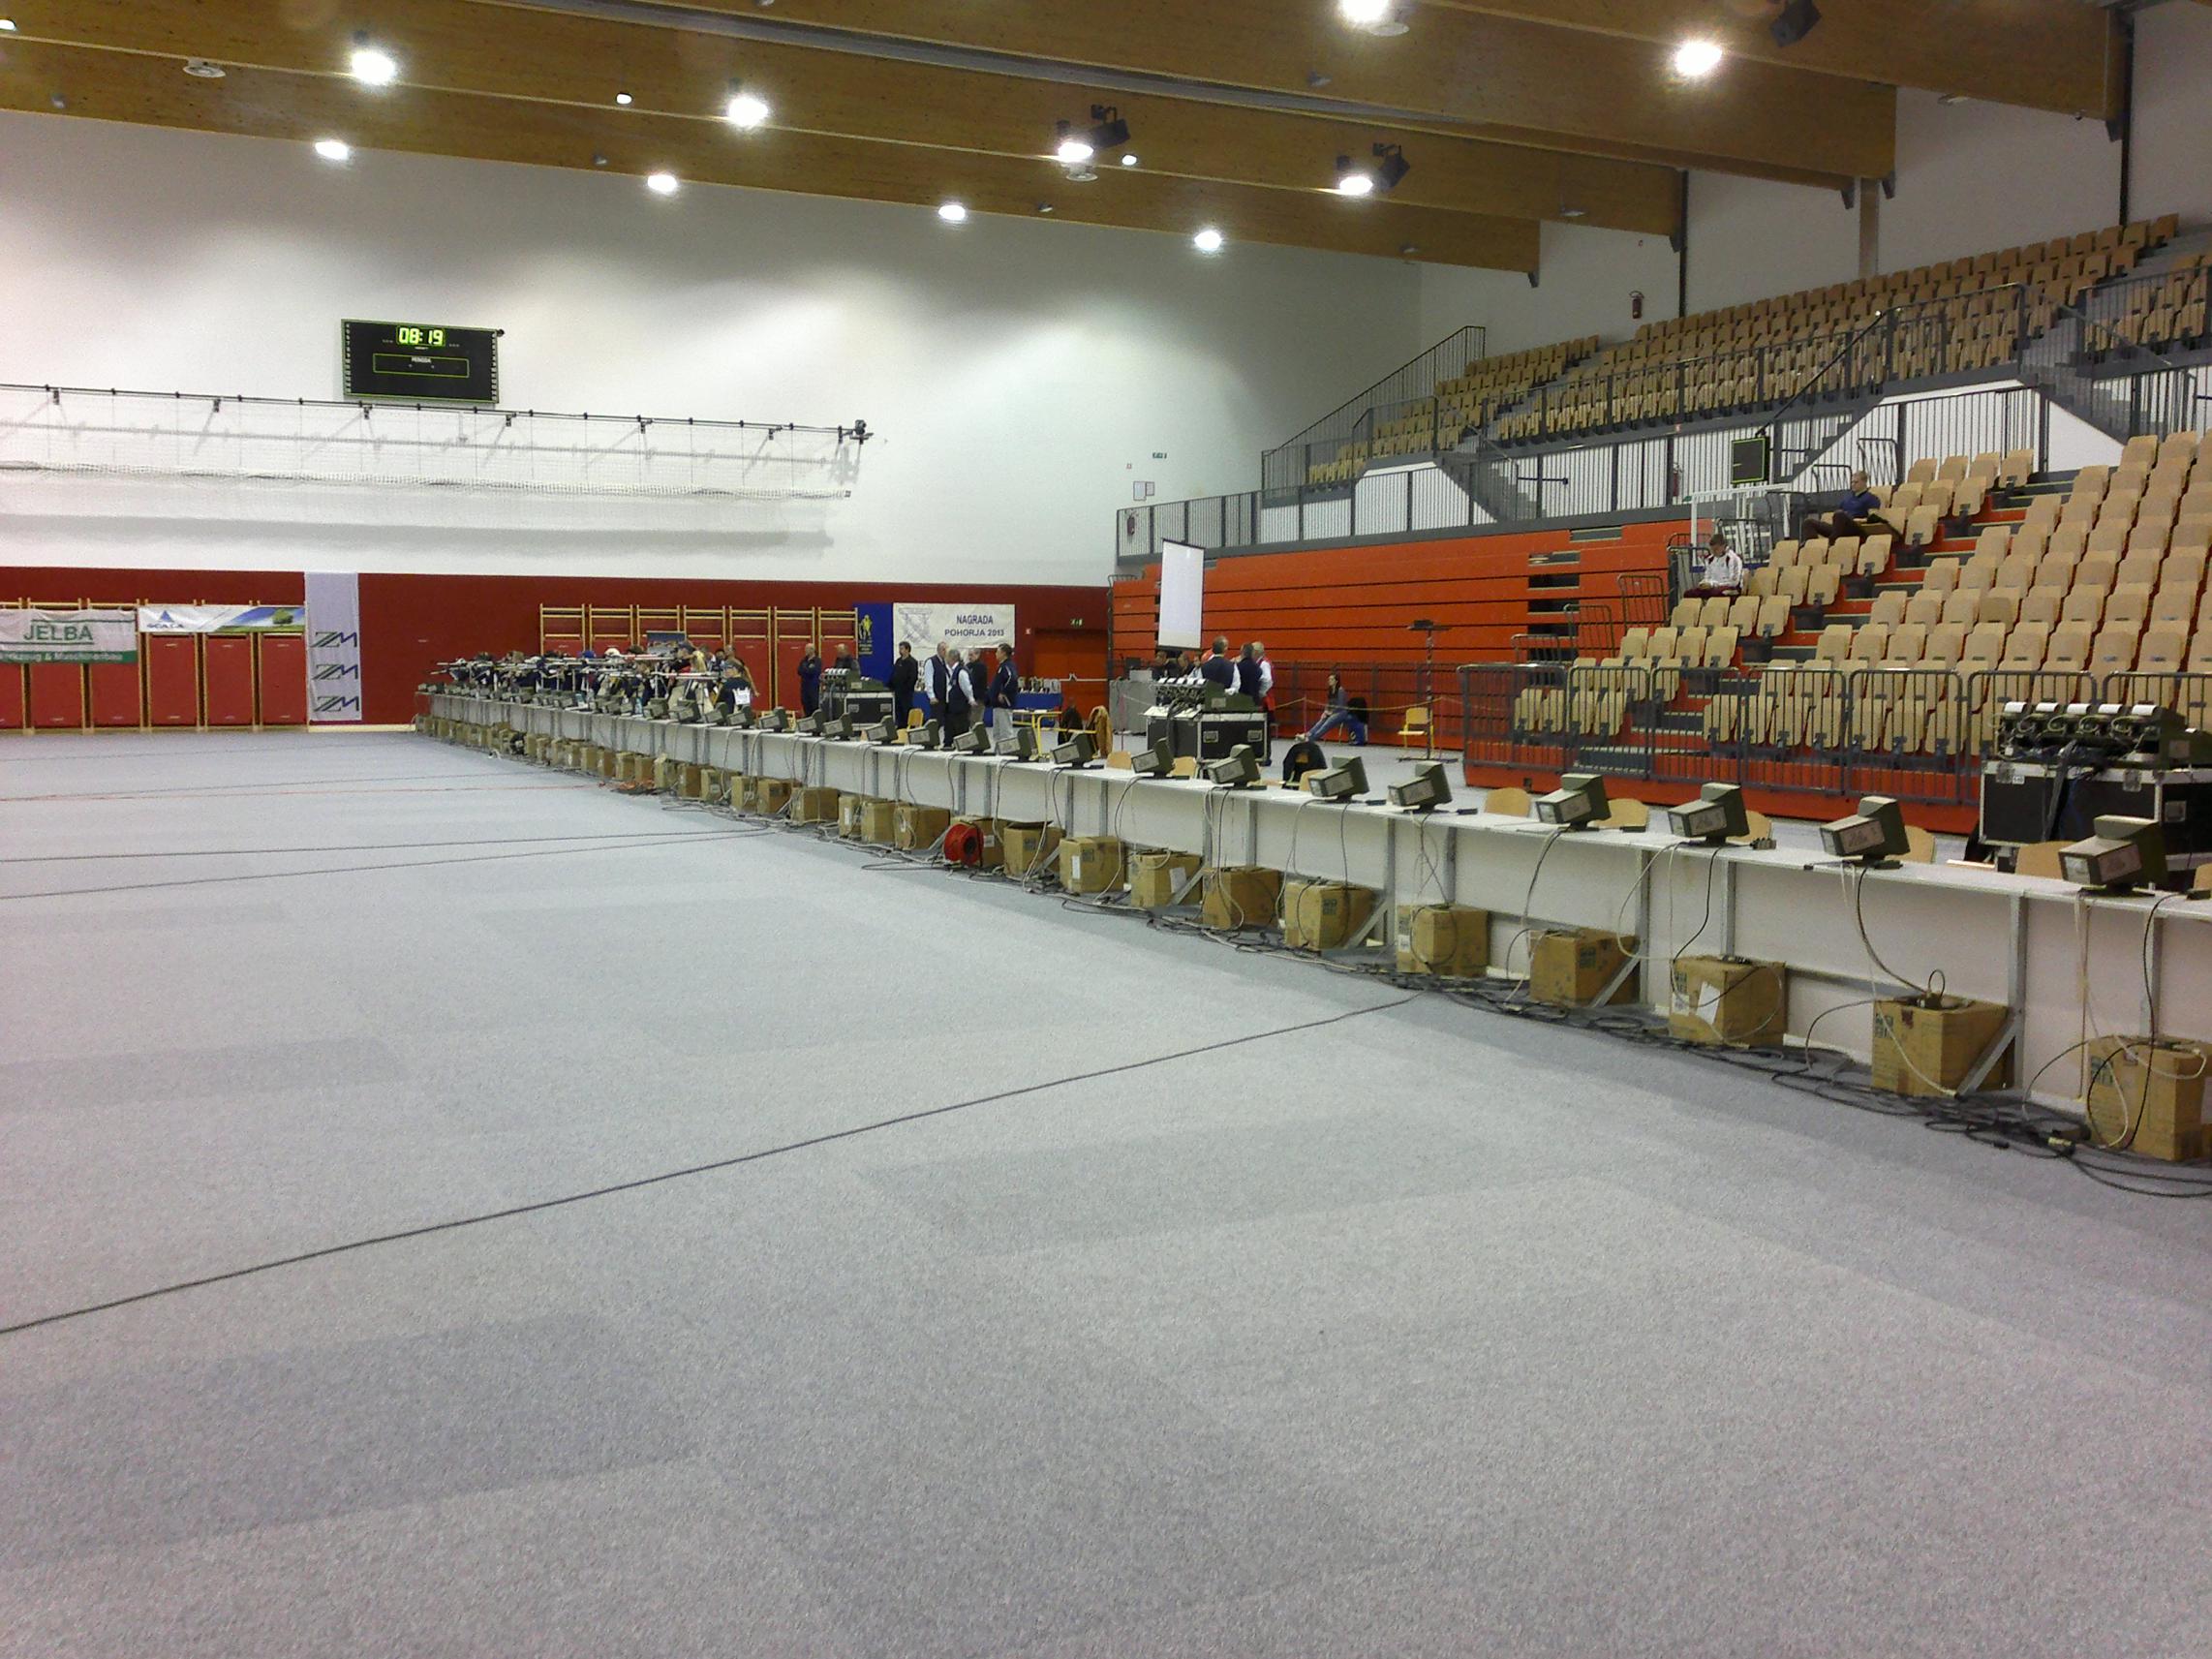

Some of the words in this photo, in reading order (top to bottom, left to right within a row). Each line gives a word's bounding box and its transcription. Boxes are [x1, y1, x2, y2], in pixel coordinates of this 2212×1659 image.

[398, 327, 444, 346] 08:19
[956, 615, 994, 625] NAGRADA
[23, 625, 94, 640] JELBA
